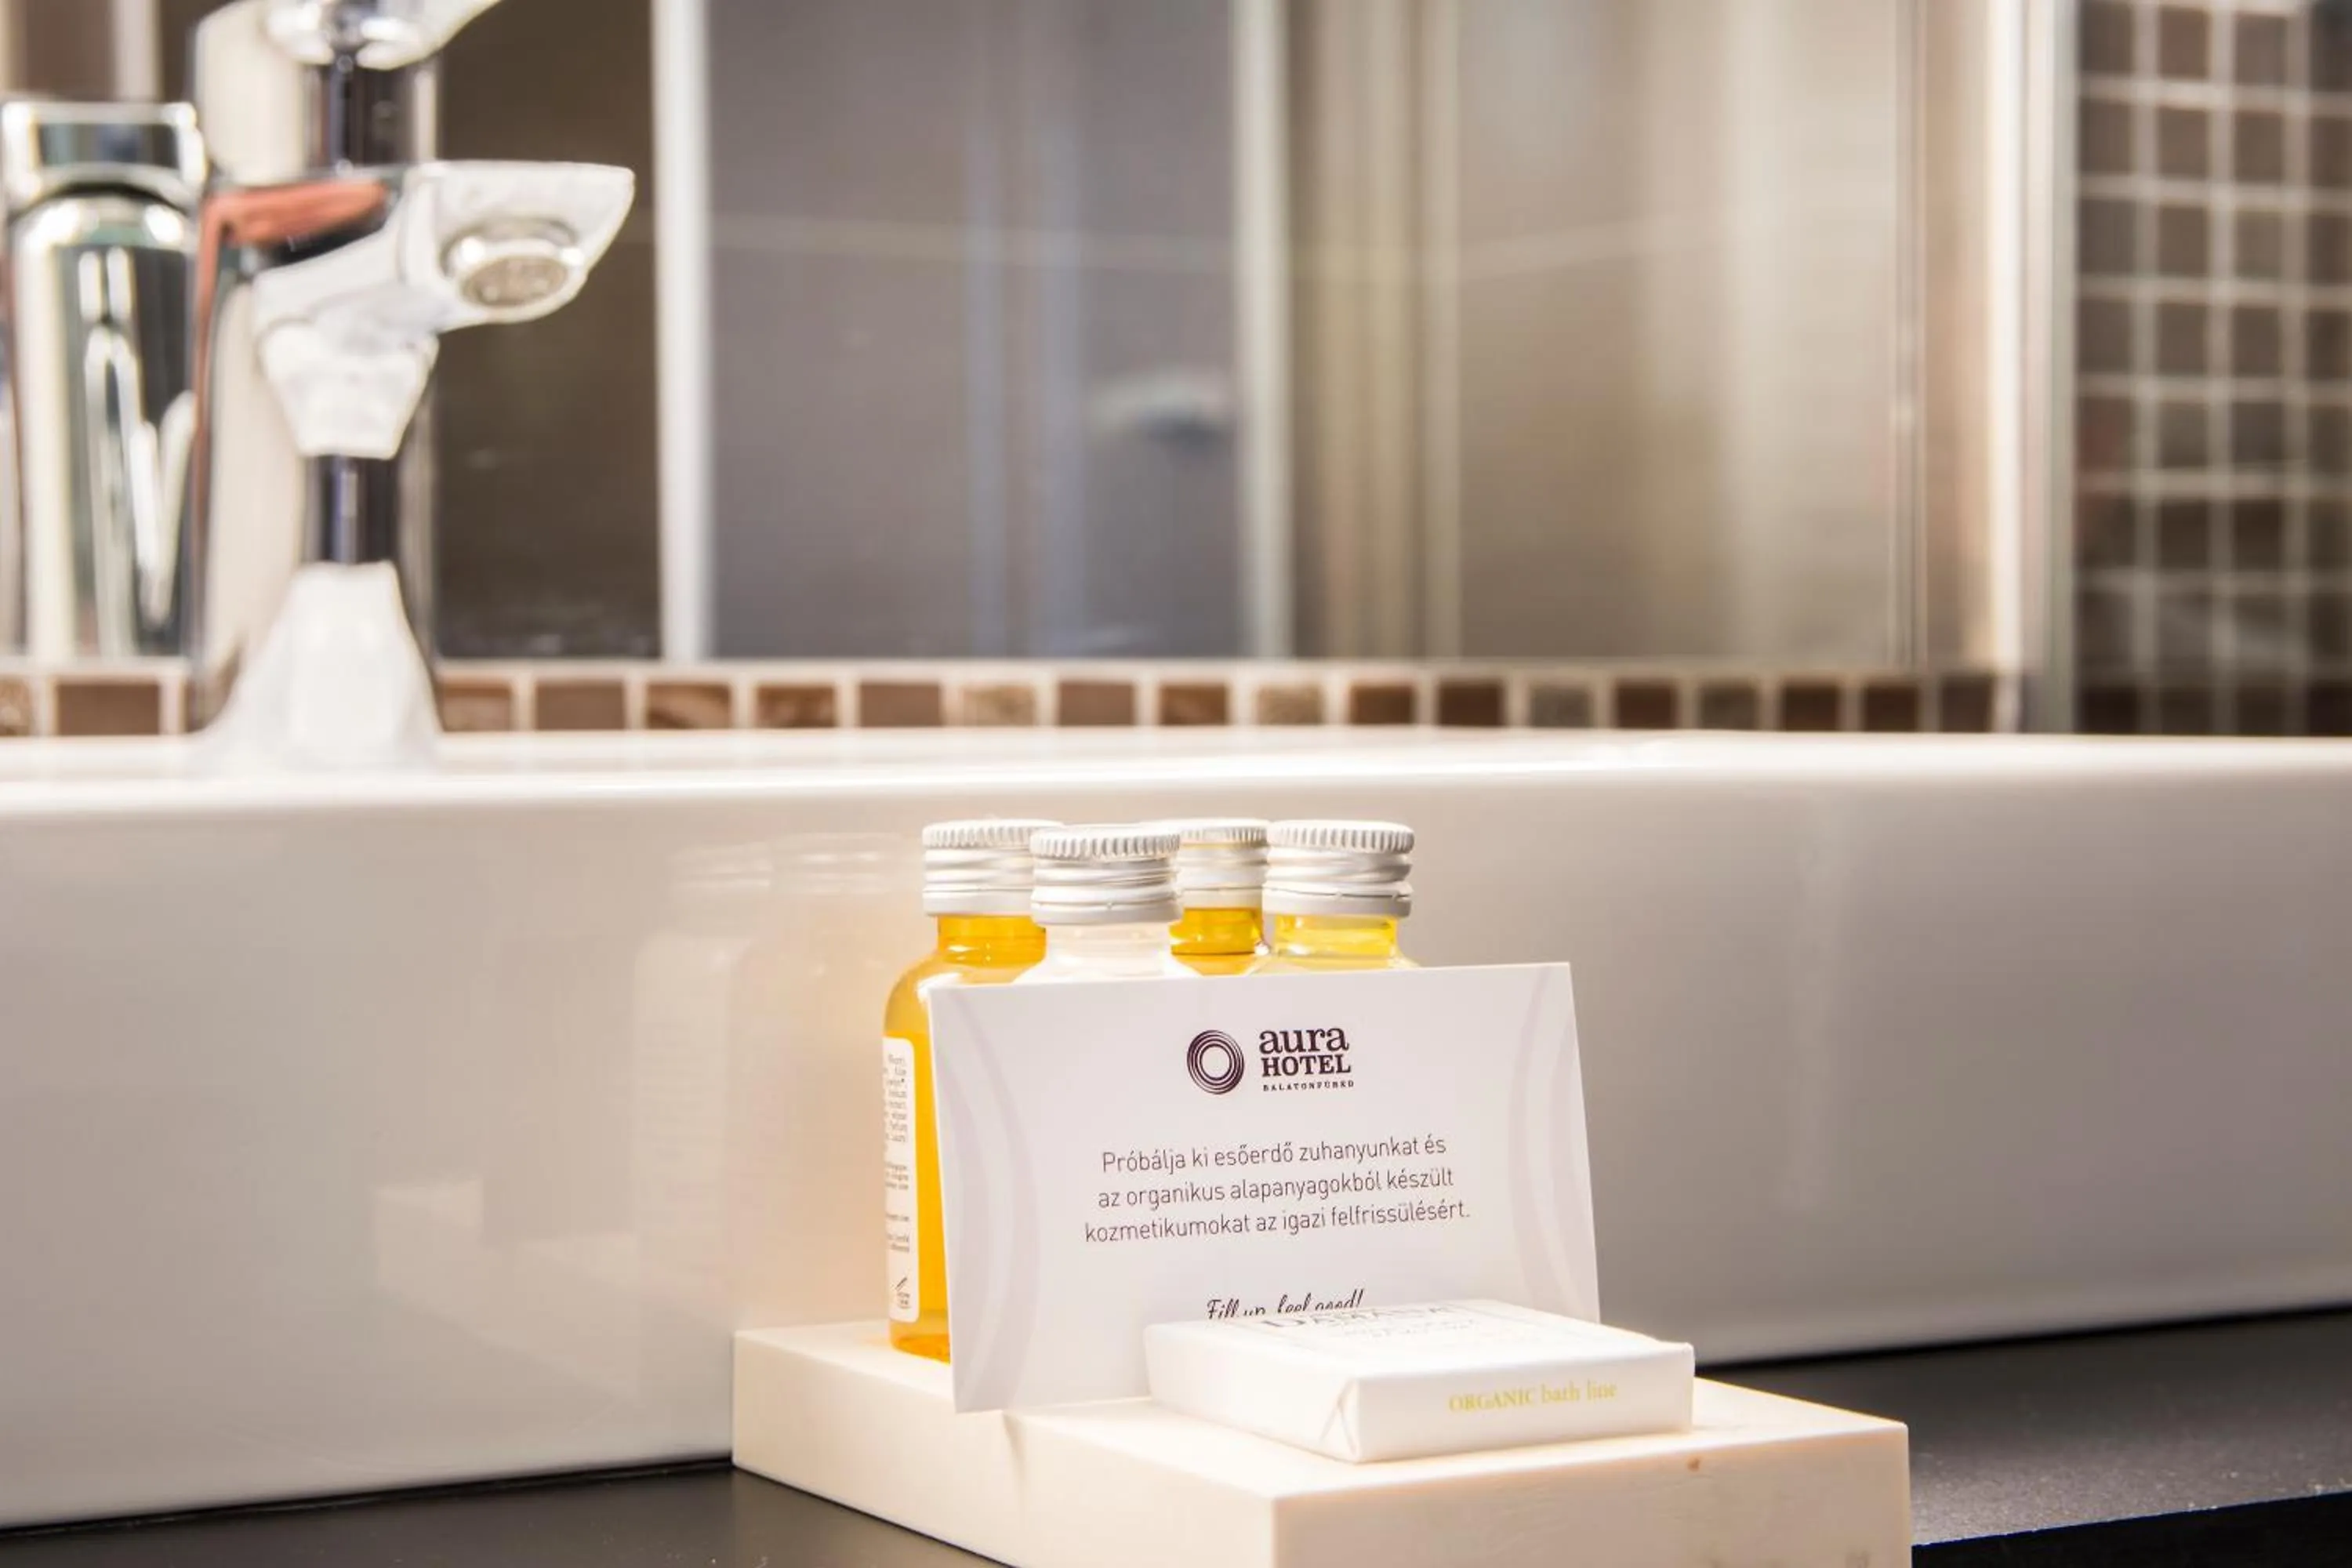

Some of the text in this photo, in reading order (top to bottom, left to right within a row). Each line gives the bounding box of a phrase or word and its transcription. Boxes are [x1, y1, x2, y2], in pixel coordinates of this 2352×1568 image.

[1259, 1027, 1349, 1054] aura
[1261, 1054, 1352, 1078] HOTEL
[1102, 1134, 1446, 1174] Próbálja ki esőerdő zuhanyunkat és
[1098, 1167, 1454, 1211] az organikus alapanyagokból készült
[1085, 1199, 1470, 1242] kozmetikumokat az igazi felfrissülésért.
[1207, 1298, 1240, 1319] Fill
[1449, 1378, 1617, 1411] ORGANIC bath line
